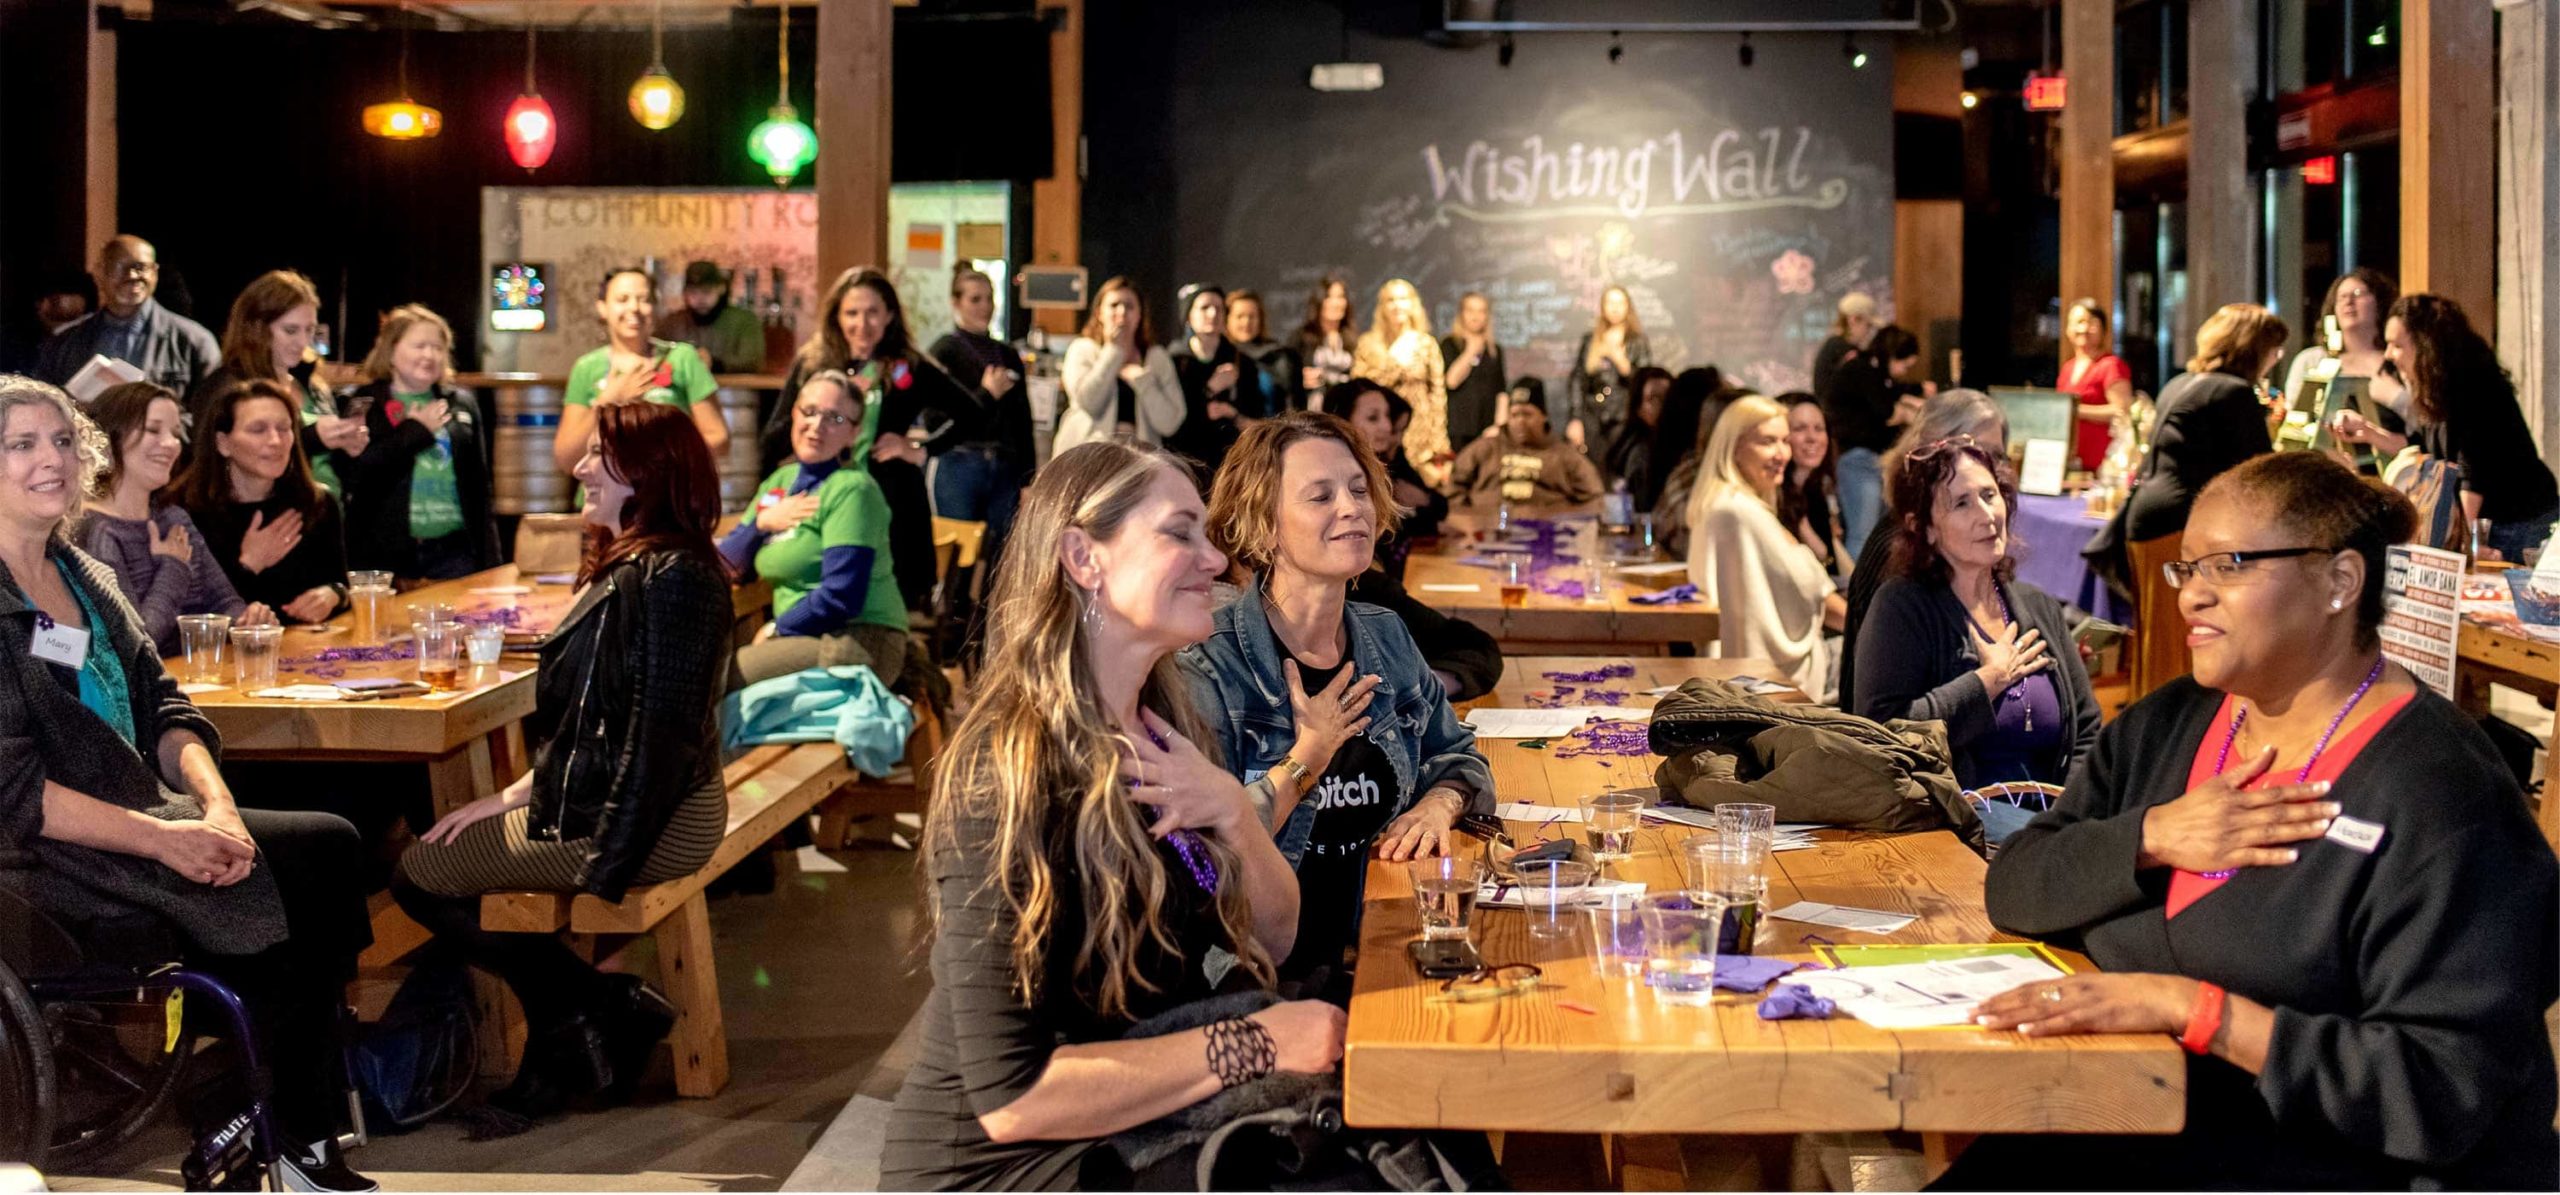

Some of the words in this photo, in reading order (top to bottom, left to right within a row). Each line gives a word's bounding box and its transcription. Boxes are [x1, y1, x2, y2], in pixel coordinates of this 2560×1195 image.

[1421, 133, 1658, 219] Wishing
[1663, 126, 1811, 204] Wall
[543, 196, 753, 228] COMMUNITY
[774, 195, 819, 229] RO
[2419, 567, 2438, 588] AMOR
[2440, 573, 2458, 592] GANA
[45, 637, 71, 654] Mary
[212, 1115, 251, 1147] TILITE
